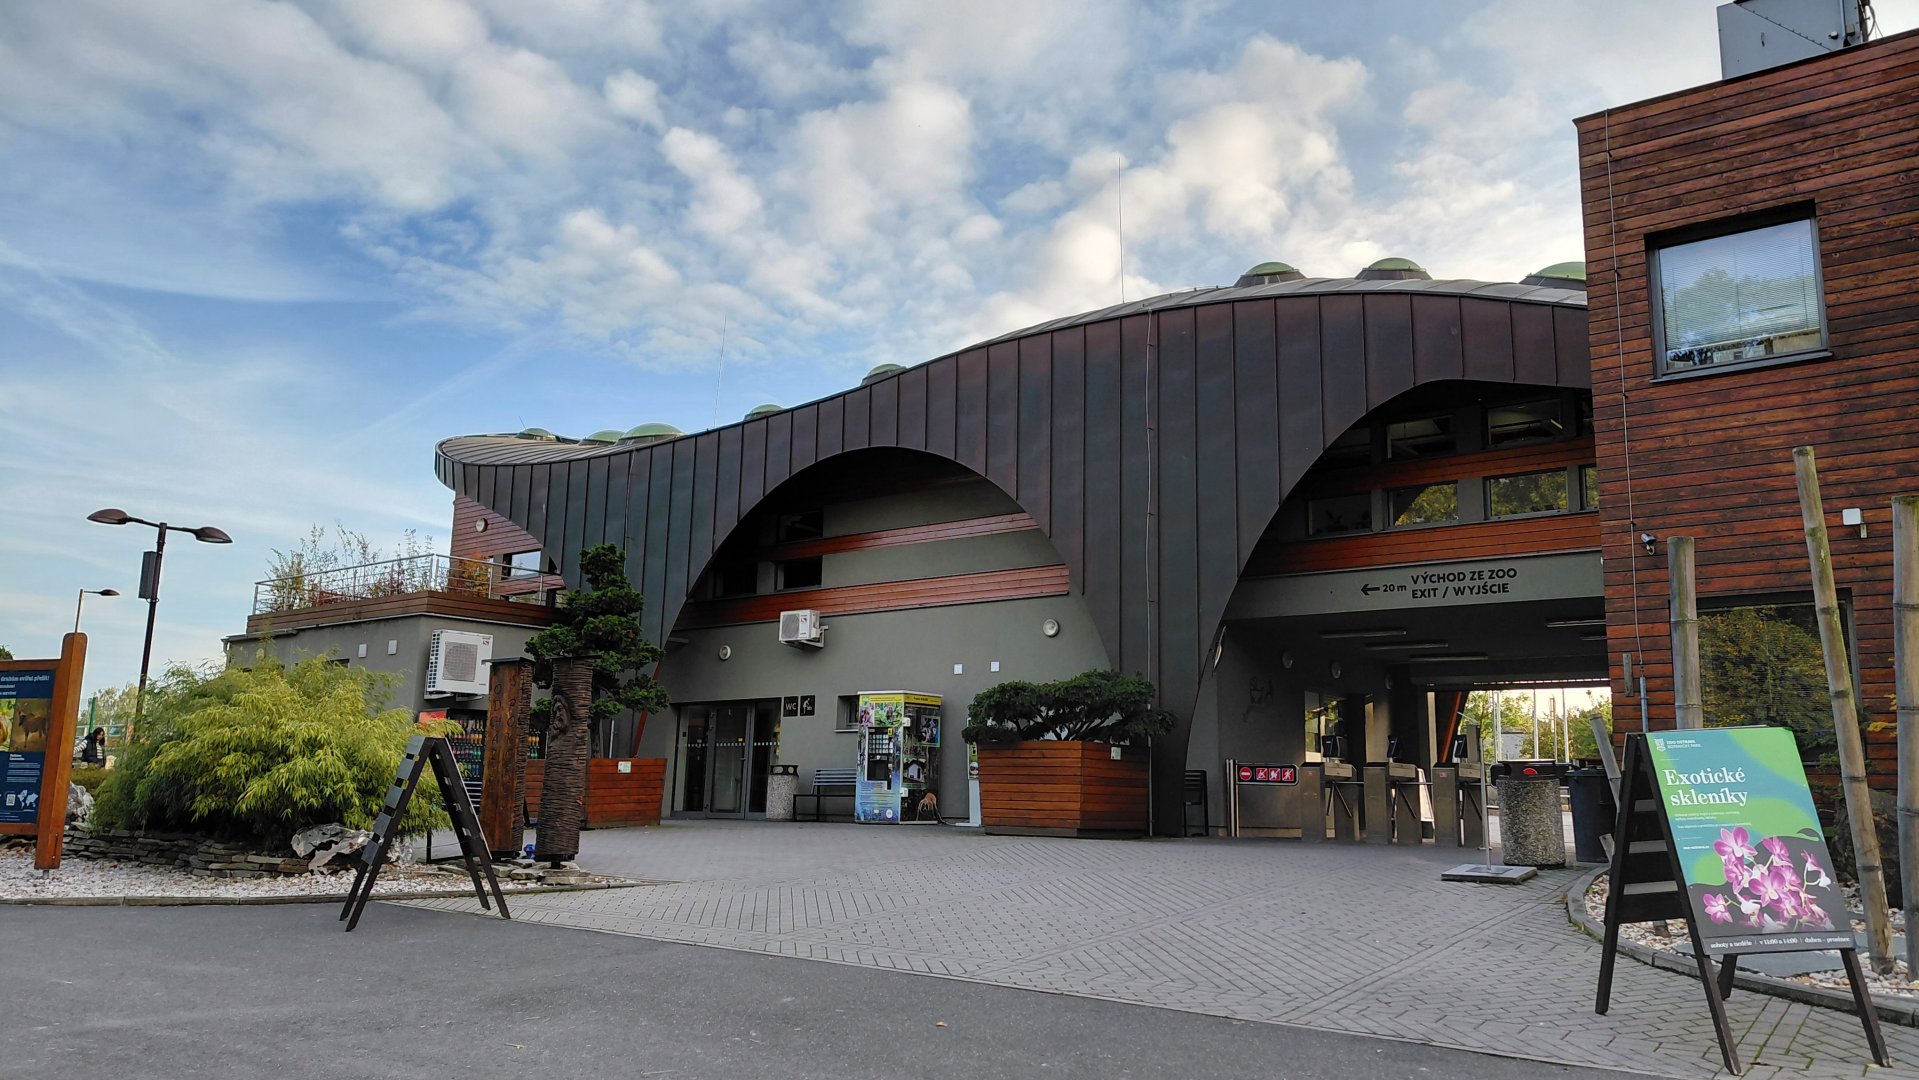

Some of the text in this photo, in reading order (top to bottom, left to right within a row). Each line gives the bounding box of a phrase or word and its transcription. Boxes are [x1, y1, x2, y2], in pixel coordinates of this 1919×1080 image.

[1411, 568, 1517, 584] VÝCHOD ZE ZOO
[1382, 584, 1407, 592] 20 m
[1411, 588, 1438, 599] EXIT
[1453, 581, 1509, 596] WYJŚCIE
[786, 702, 796, 710] WC
[1662, 766, 1746, 786] Exotické
[1670, 788, 1748, 806] skleníky
